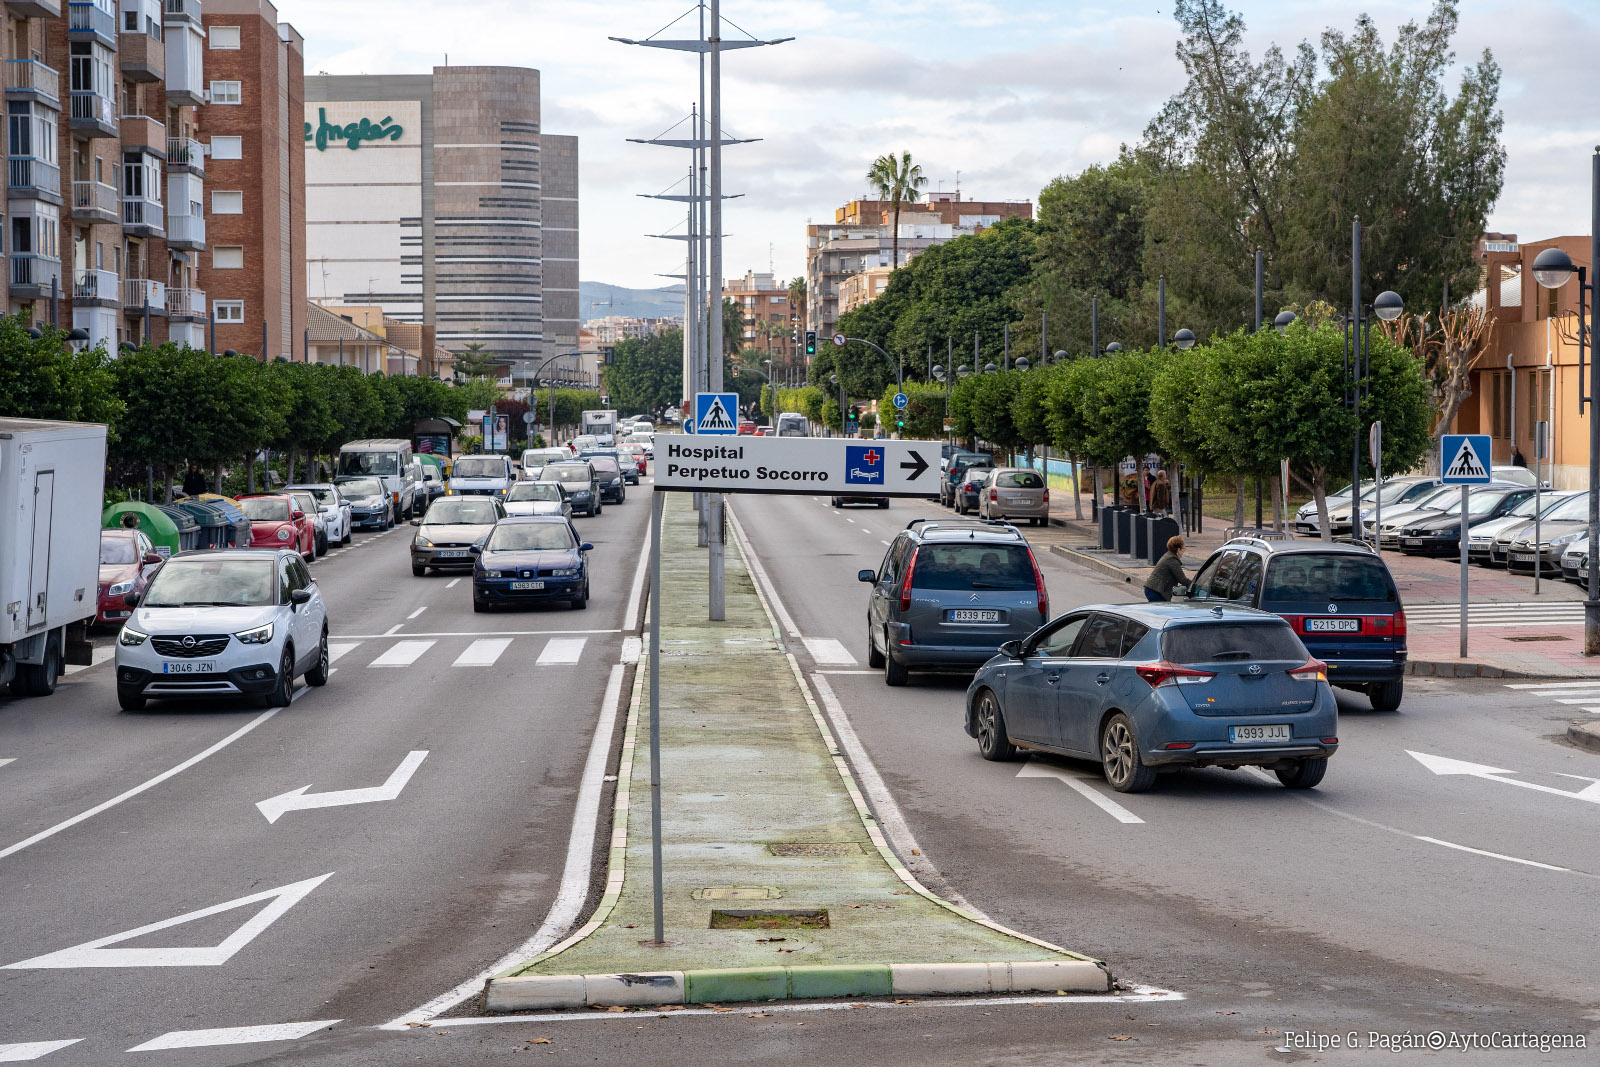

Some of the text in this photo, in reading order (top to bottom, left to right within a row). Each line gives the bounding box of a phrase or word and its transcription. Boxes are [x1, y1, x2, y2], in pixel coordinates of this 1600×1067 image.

[316, 108, 403, 152] Inglés
[668, 444, 744, 461] Hospital
[667, 464, 829, 482] Perpetuo Socorro
[956, 611, 996, 620] 8339 FDZ
[1313, 620, 1356, 630] 5215 DPC
[170, 663, 213, 672] 3046 JZN
[1237, 726, 1288, 739] 4993 JJL
